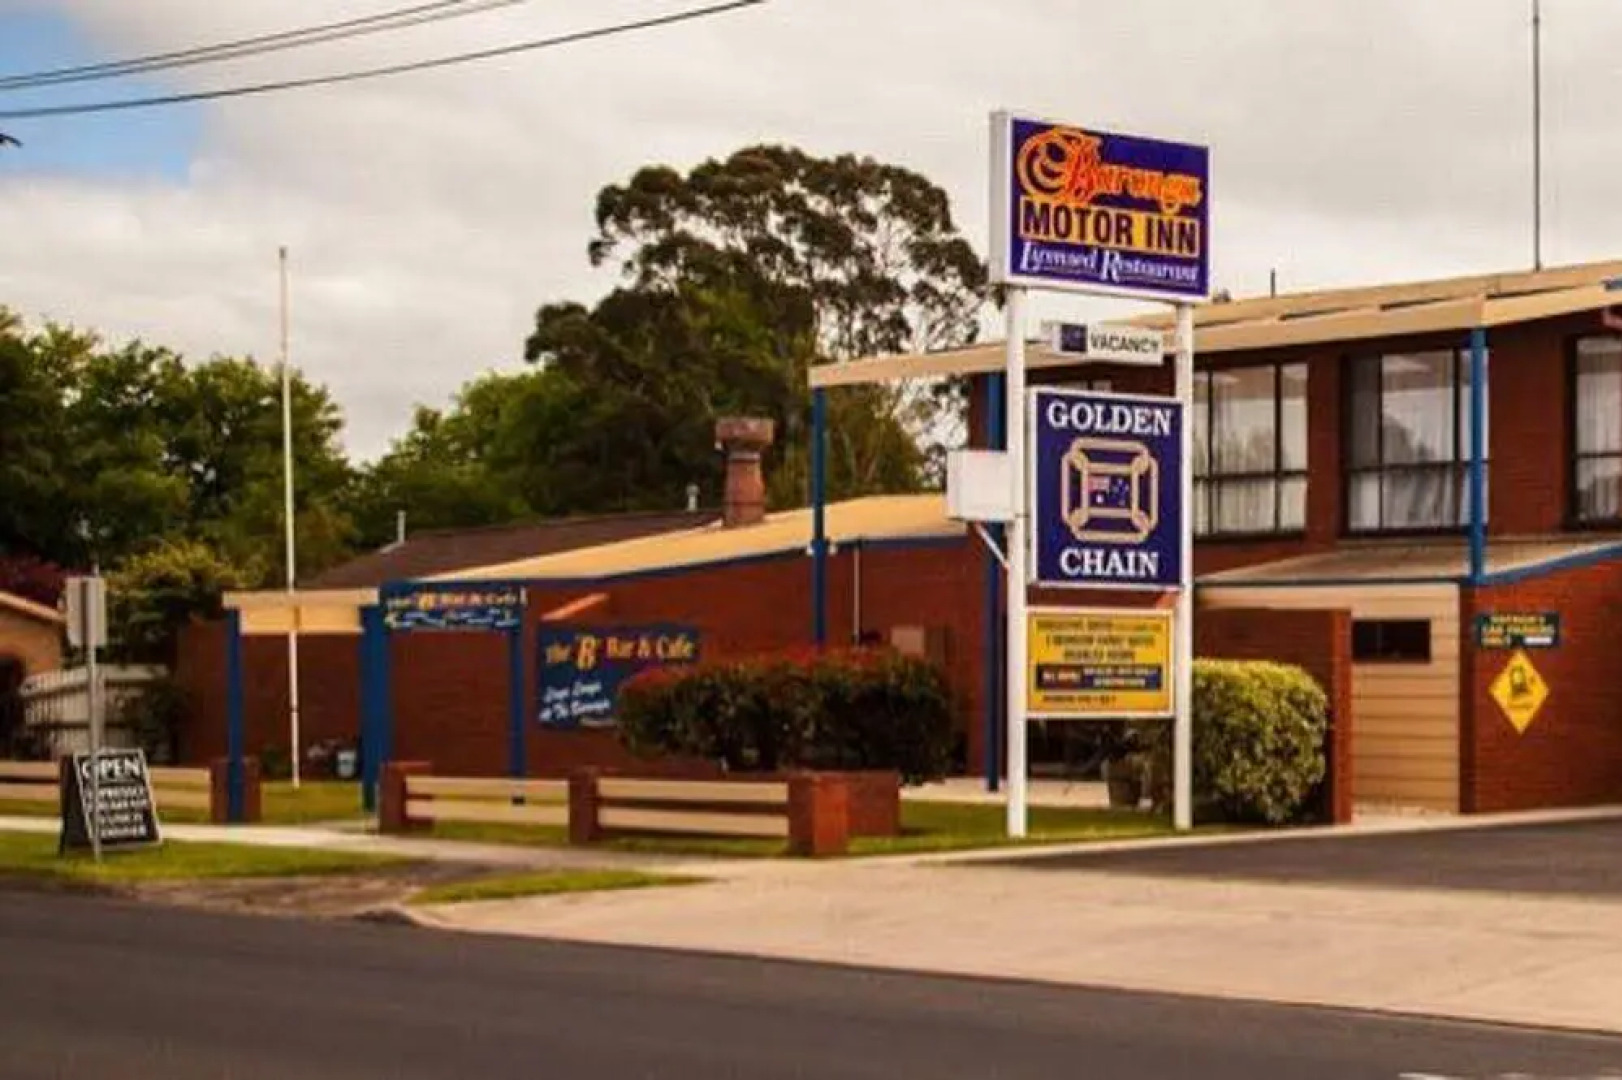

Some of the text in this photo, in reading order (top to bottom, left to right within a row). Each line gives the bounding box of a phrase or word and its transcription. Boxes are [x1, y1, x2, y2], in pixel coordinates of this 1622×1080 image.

[1022, 199, 1198, 254] MOTOR INN
[1090, 333, 1160, 353] VACANCY
[1047, 402, 1172, 436] GOLDEN
[1059, 548, 1160, 576] CHAIN
